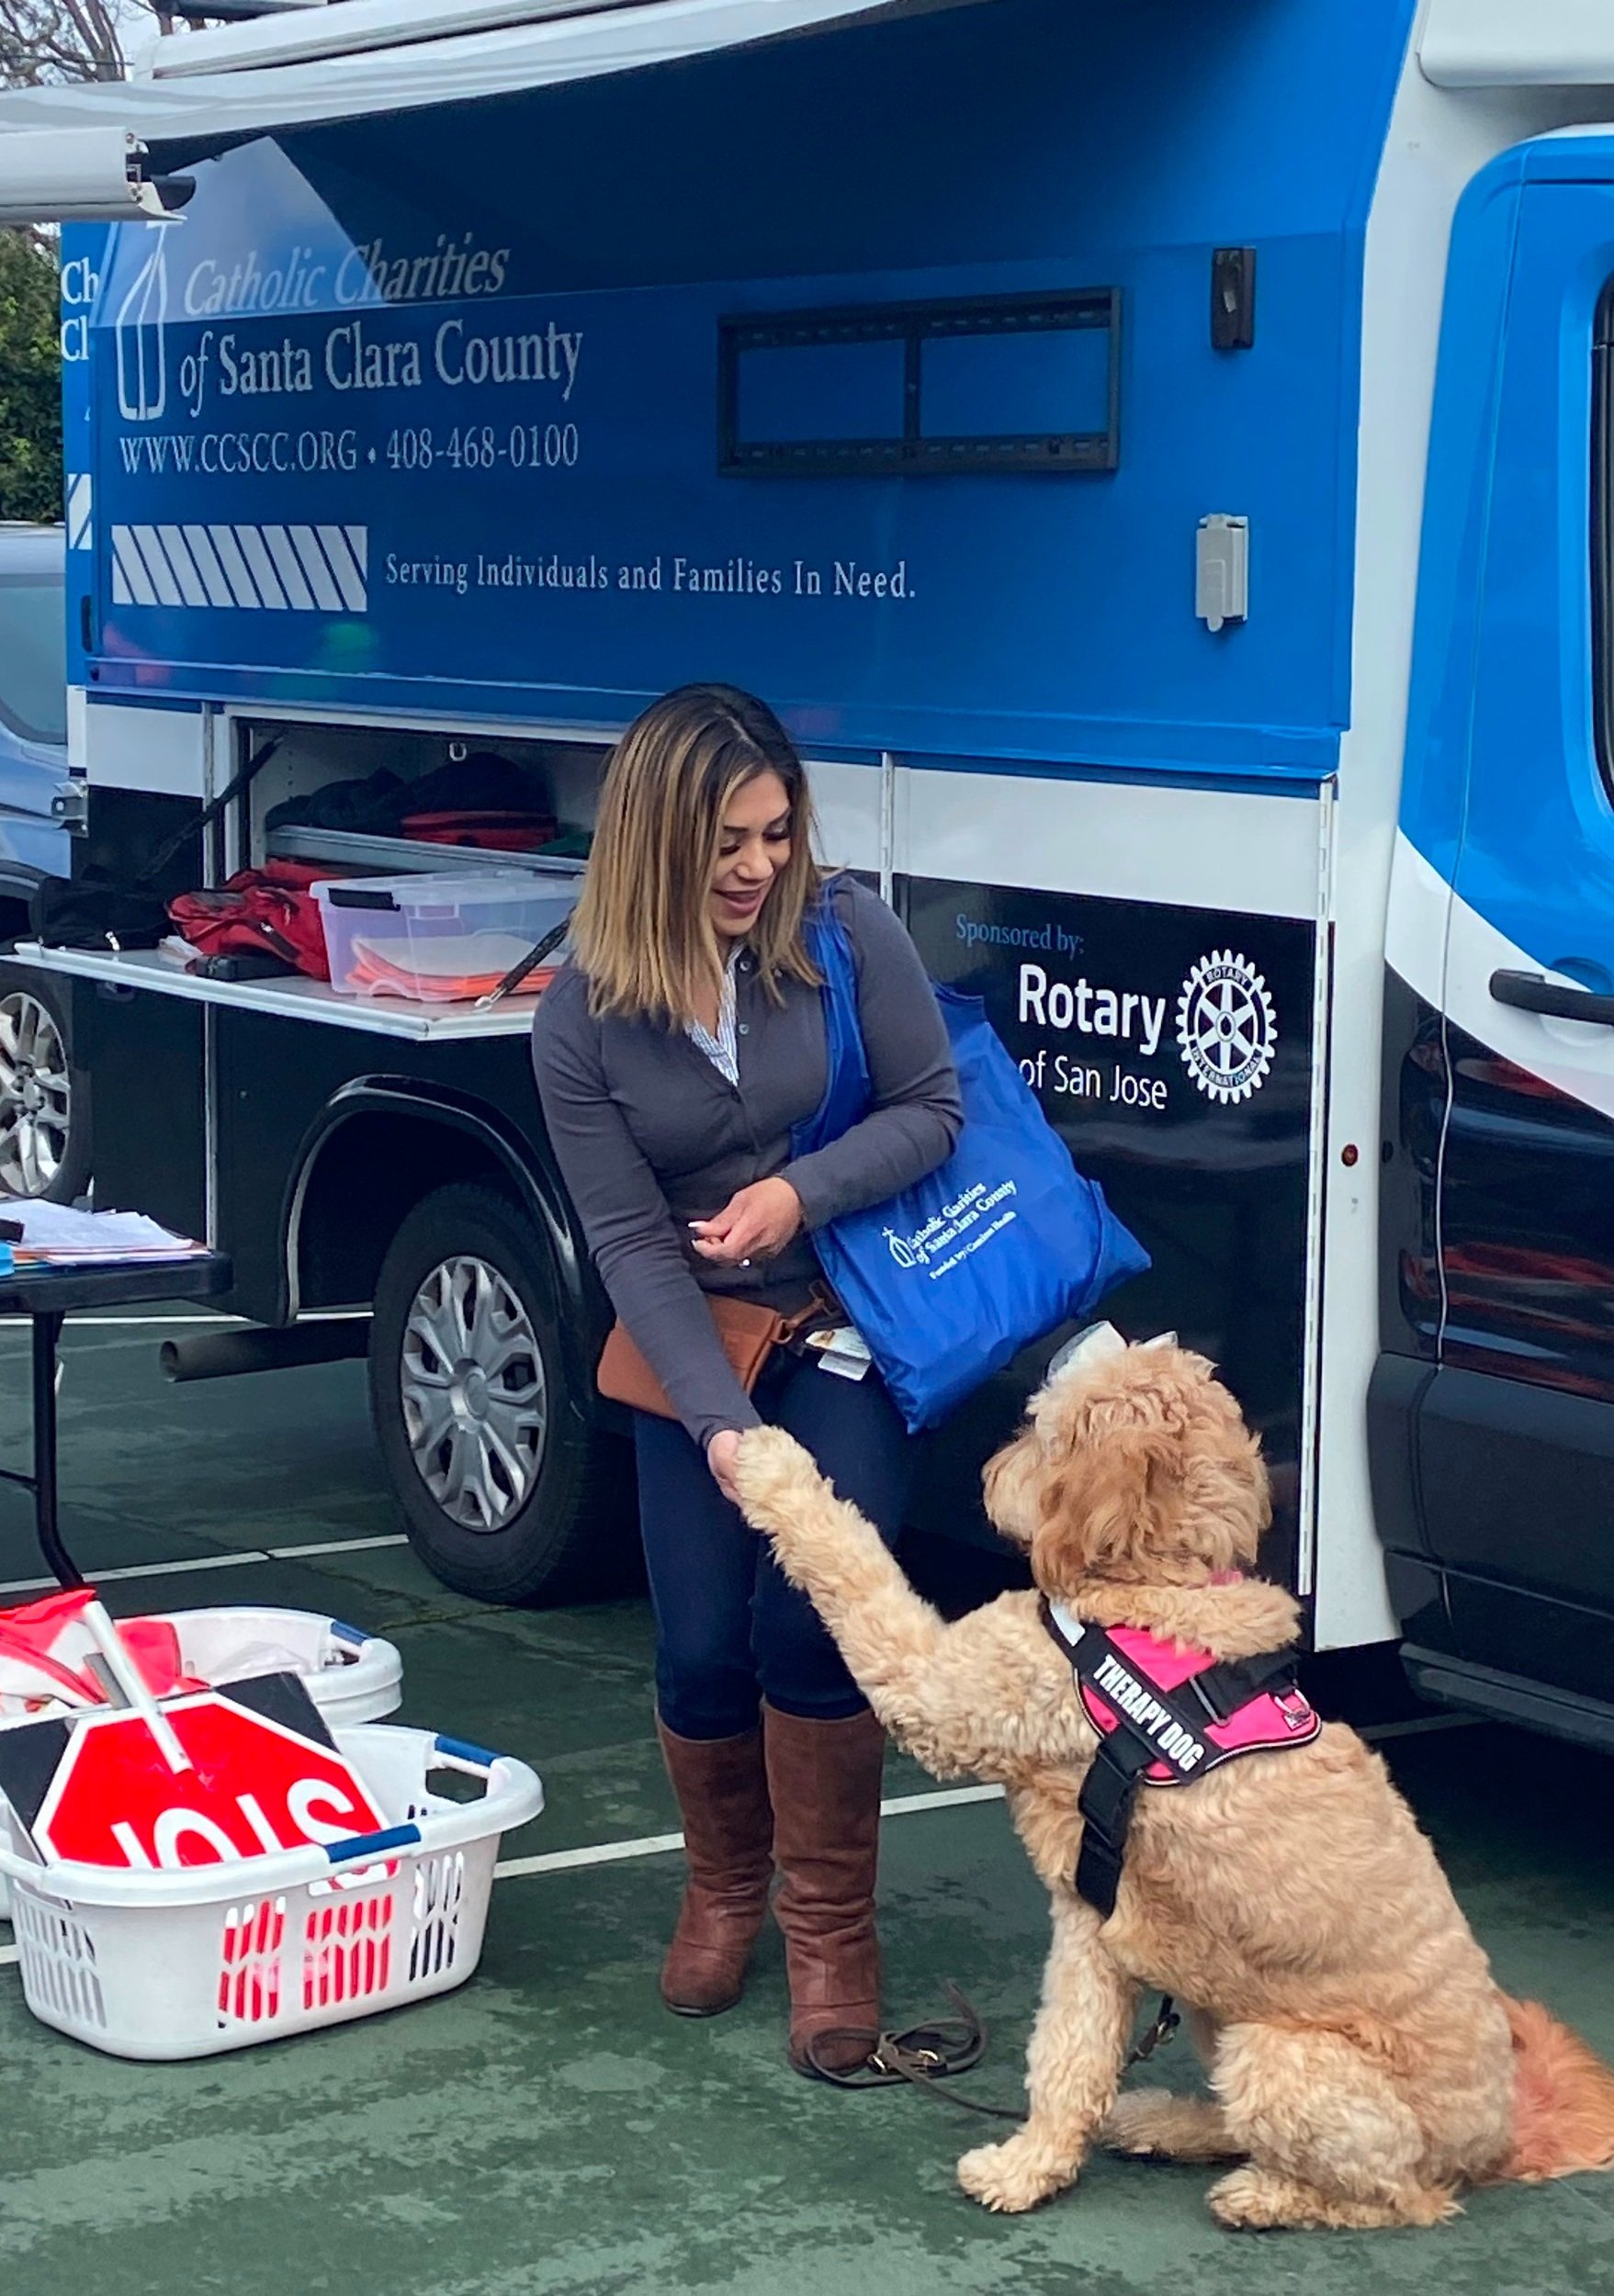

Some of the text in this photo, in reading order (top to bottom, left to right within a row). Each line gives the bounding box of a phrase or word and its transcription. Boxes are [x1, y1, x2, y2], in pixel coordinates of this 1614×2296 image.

[185, 232, 511, 316] Catholic Charities
[179, 319, 582, 418] of Santa Clara County
[119, 423, 579, 475] WWW.CCSCC.ORG 408-468-0100
[385, 553, 916, 599] Serving Individuals and Families In Need.
[955, 914, 1053, 951] Sponsored
[1205, 966, 1249, 986] ROTARY
[1019, 963, 1166, 1056] Rotary
[1019, 1050, 1168, 1109] of San Jose
[924, 1227, 957, 1254] Santa
[976, 1180, 1017, 1211] County
[1093, 1654, 1204, 1772] THERAPY DOG
